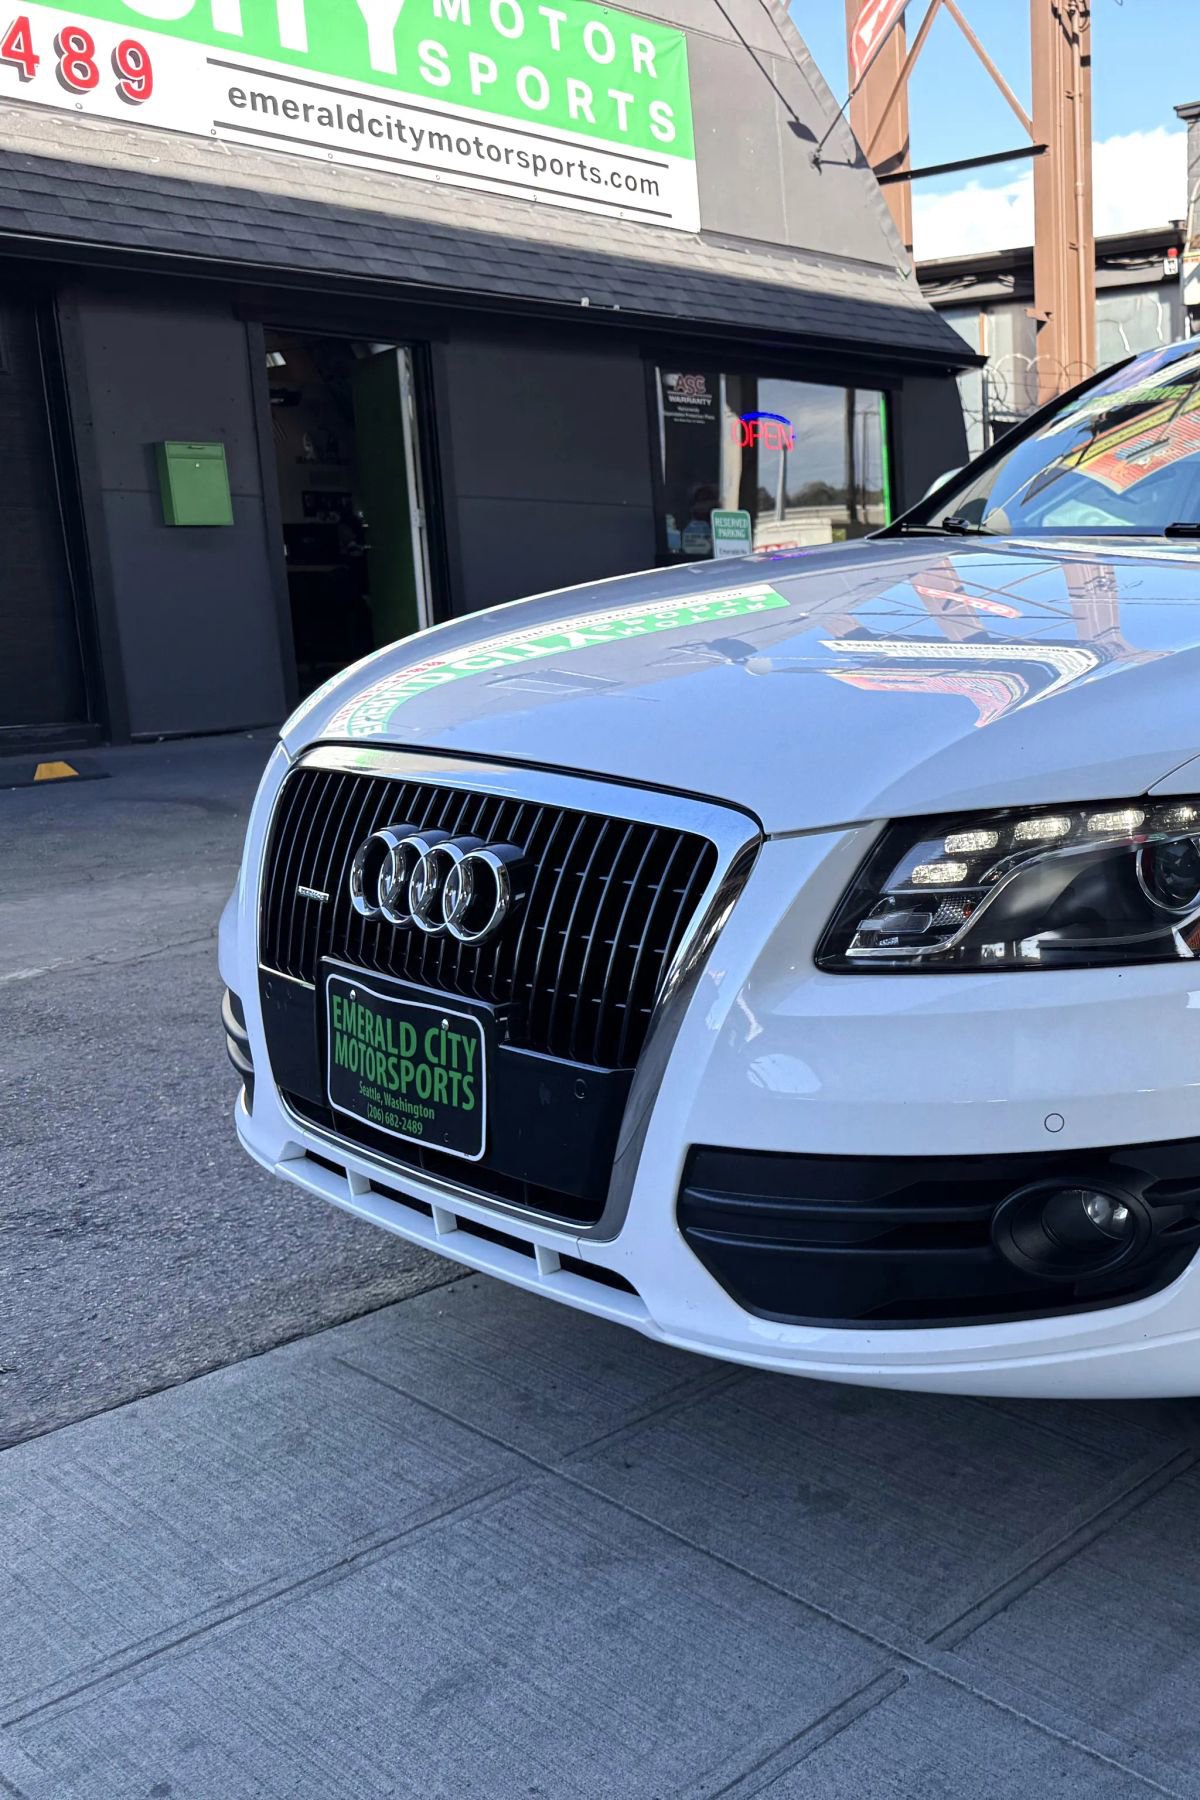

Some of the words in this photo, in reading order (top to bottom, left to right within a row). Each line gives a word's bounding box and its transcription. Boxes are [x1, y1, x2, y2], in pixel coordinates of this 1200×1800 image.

[433, 0, 657, 78] MOTOR
[419, 40, 676, 142] SPORTS
[228, 87, 660, 197] emeraldcitymotorsports.com
[668, 396, 712, 406] WARRANTY
[732, 419, 794, 452] OPEN
[714, 517, 748, 528] RESERVED
[719, 528, 745, 538] PARKING
[333, 995, 418, 1057] EMERALD
[424, 1027, 477, 1073] CITY
[335, 1032, 475, 1111] MOTORSPORTS
[359, 1081, 383, 1106] Seattle,
[383, 1092, 435, 1120] Washington
[367, 1104, 384, 1124] (206)
[385, 1112, 423, 1135] 682-2489
